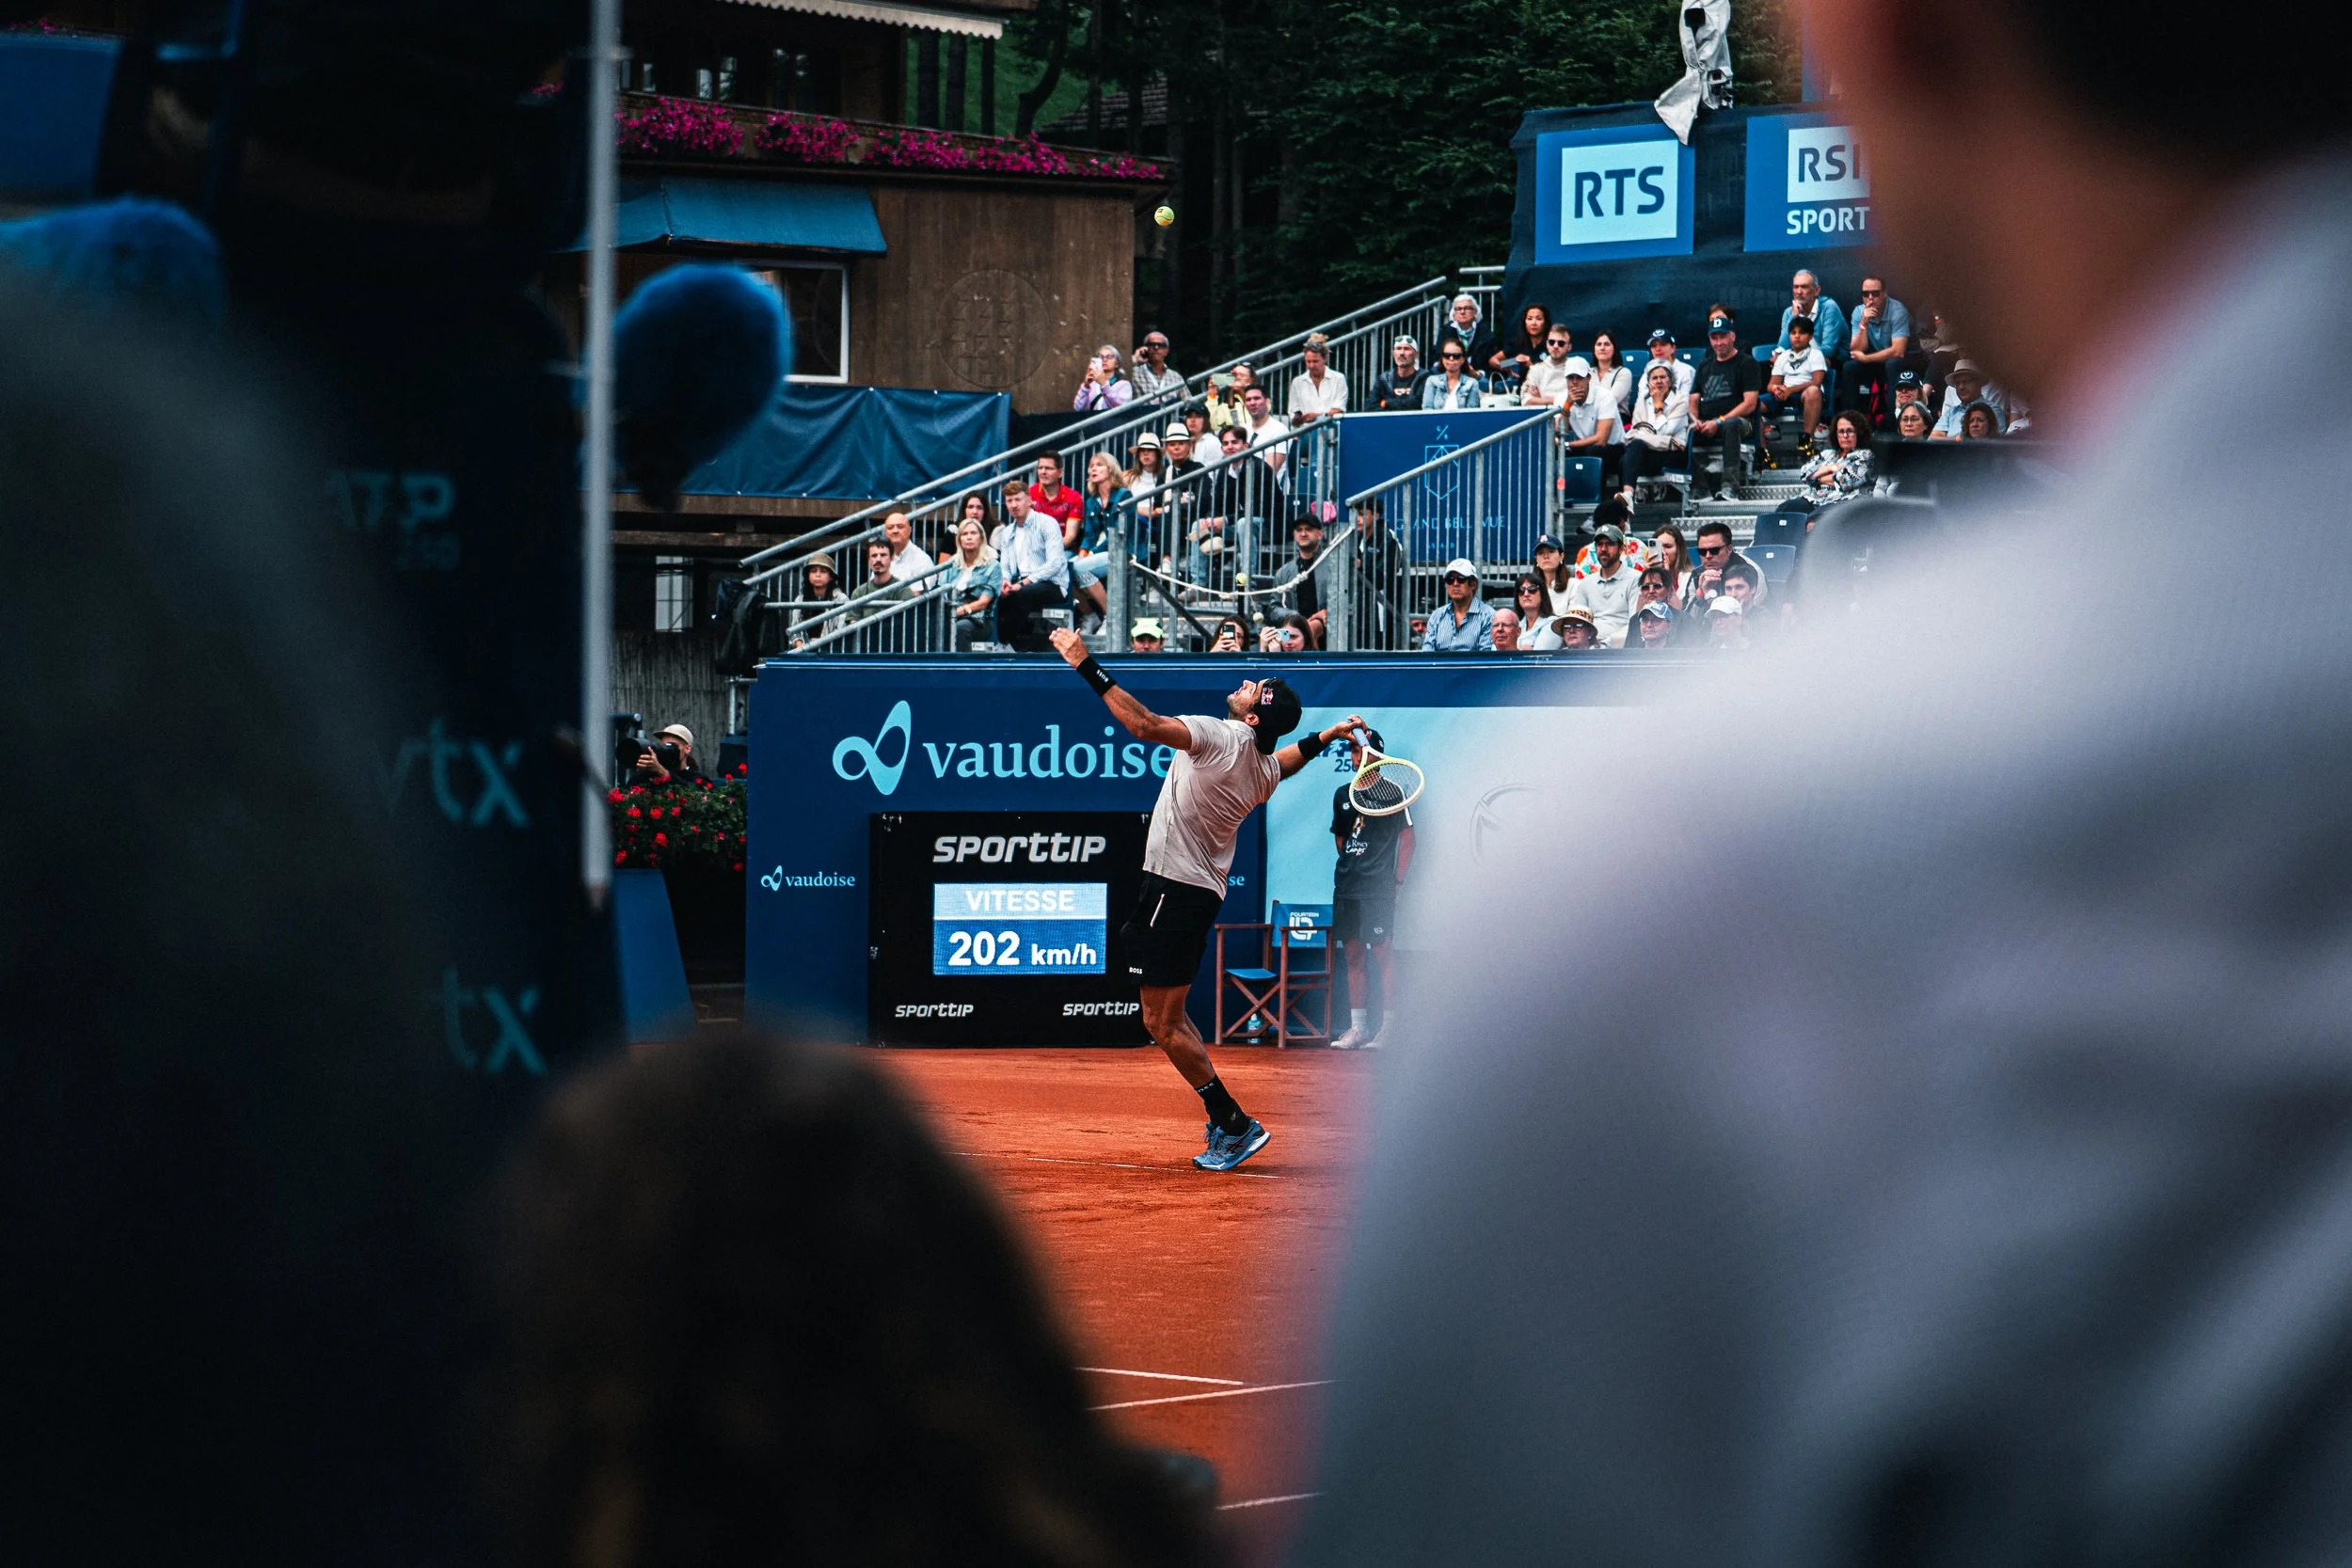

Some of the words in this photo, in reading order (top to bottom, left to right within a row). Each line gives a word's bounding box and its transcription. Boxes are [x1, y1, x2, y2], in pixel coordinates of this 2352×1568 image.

[1798, 144, 1861, 183] RSI
[1574, 166, 1665, 219] RTS
[1786, 206, 1871, 235] SPORT
[923, 724, 1176, 779] vaudoise
[785, 871, 856, 887] vaudoise
[965, 889, 1075, 911] VITESSE
[948, 930, 1021, 966] 202
[1031, 943, 1097, 966] km/h
